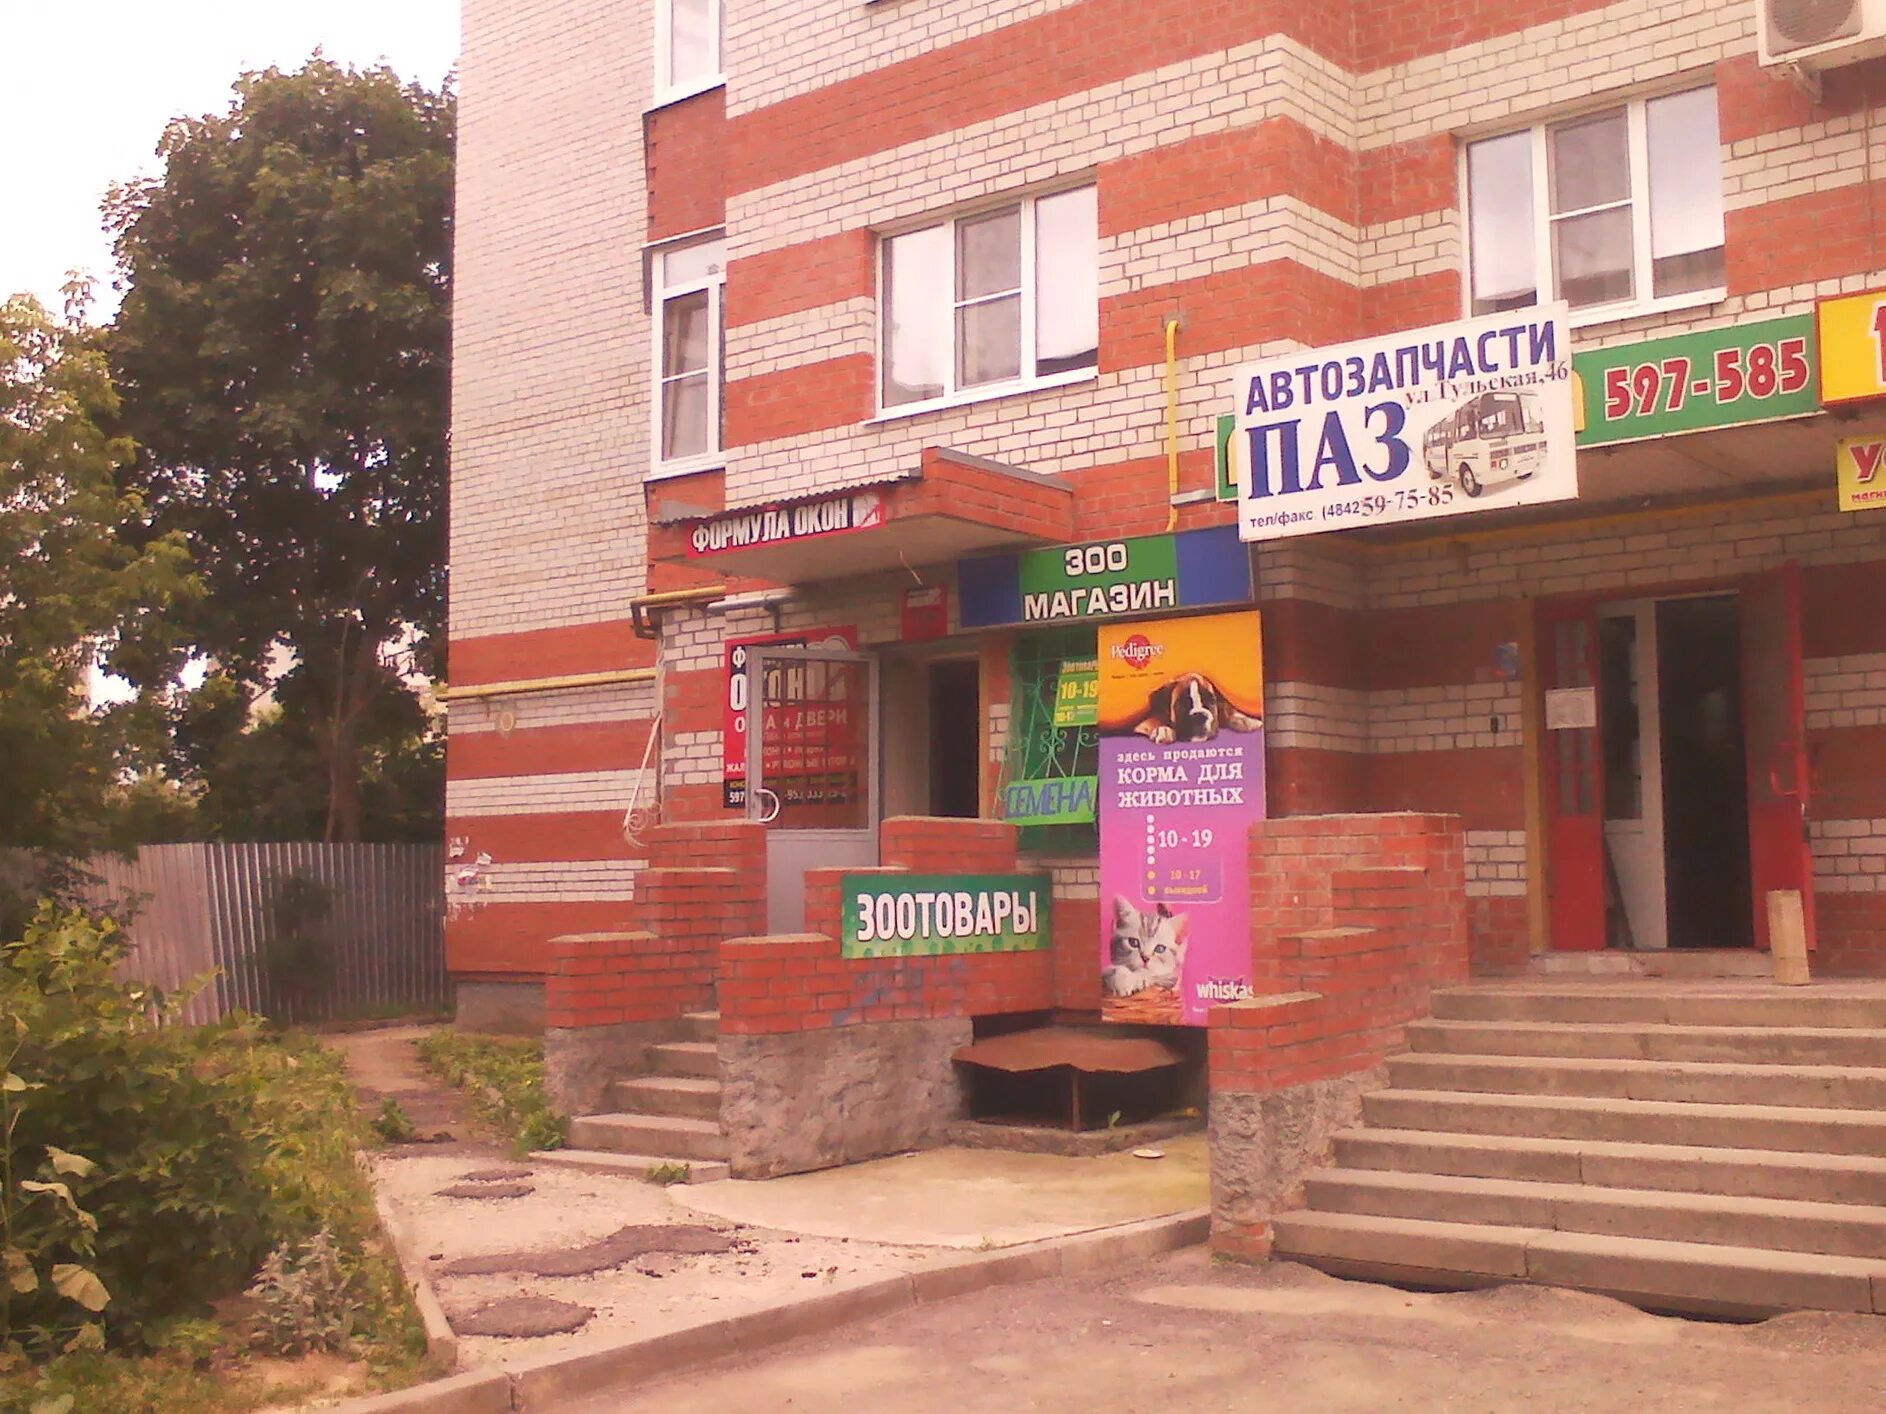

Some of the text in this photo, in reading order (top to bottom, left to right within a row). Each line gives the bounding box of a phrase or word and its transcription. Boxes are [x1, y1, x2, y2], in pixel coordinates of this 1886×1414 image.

[1246, 320, 1555, 415] АВТОЗАПЧАСТИ
[1604, 337, 1809, 421] 597-585
[1245, 401, 1410, 499] ПАЗ
[692, 499, 849, 552] ФОРМУЛА ОКОН
[1064, 543, 1128, 576] ЗОО
[1024, 579, 1175, 620] МАГАЗИН
[1111, 642, 1164, 662] Pedigree
[1117, 747, 1243, 763] здесь продаются
[1118, 763, 1243, 785] КОРМА ДЛЯ
[1118, 788, 1244, 808] ЖИВОТНЫХ
[857, 891, 1037, 941] ЗООТОВАРЫ
